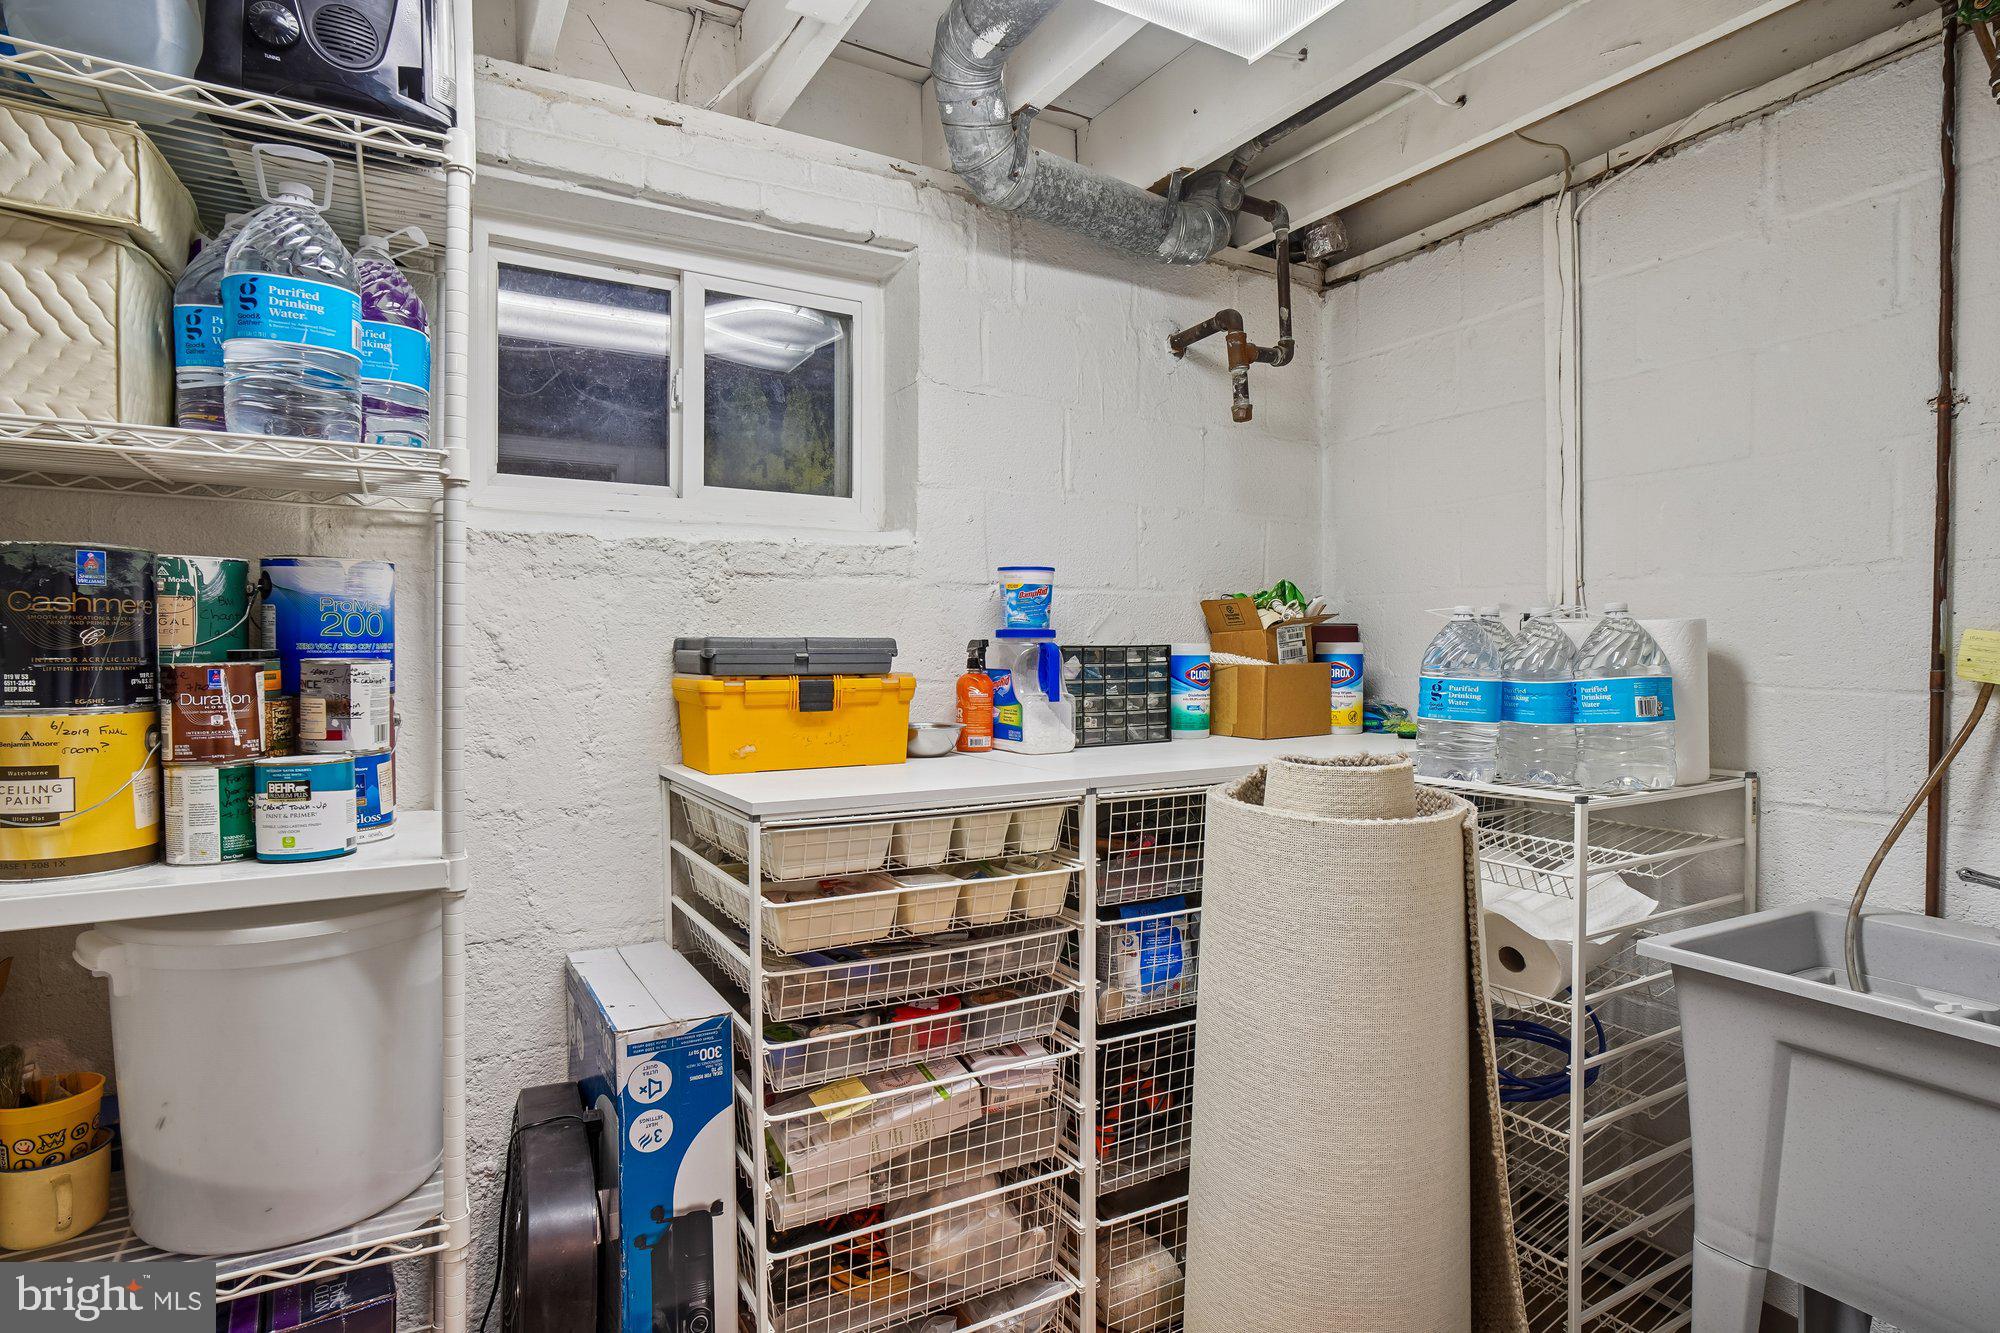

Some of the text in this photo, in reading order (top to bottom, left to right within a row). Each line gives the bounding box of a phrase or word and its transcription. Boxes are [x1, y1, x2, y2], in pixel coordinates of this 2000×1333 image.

[269, 285, 319, 302] Purified
[269, 296, 325, 315] Drinking
[361, 329, 386, 340] ified
[361, 339, 392, 353] nking
[7, 590, 153, 616] Cashmere
[158, 617, 190, 626] GAL
[320, 612, 383, 637] 200
[1448, 685, 1479, 693] Purified
[1580, 685, 1608, 693] Purified
[180, 693, 251, 706] Duraton
[1448, 692, 1482, 701] Drinking
[1581, 693, 1612, 701] Drinking
[0, 784, 63, 795] CEILING
[268, 783, 296, 794] BEHR
[5, 795, 53, 806] PAINT
[31, 861, 50, 869] 508
[699, 1045, 723, 1061] 300
[642, 1063, 659, 1071] QUIET
[642, 1069, 659, 1077] ULTRA
[639, 1114, 664, 1125] SETTINGS
[653, 1128, 663, 1143] 3
